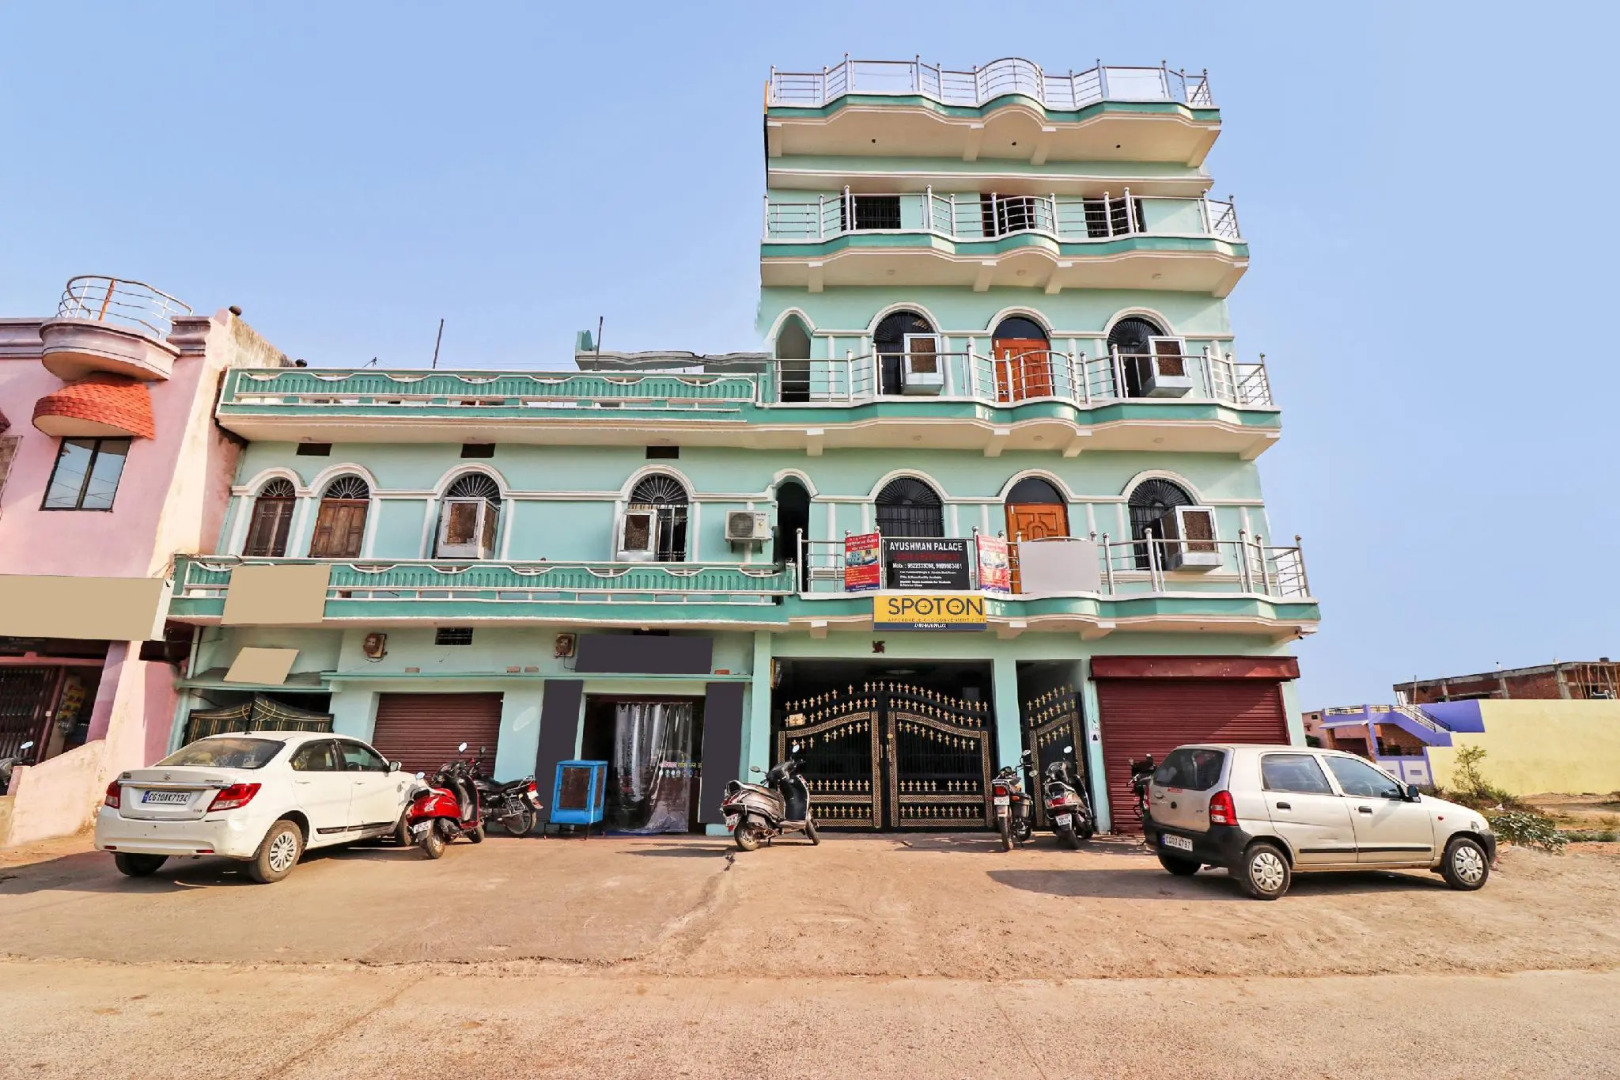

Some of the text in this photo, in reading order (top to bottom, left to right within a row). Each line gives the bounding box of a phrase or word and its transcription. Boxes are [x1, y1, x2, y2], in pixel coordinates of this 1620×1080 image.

[889, 541, 932, 551] AYUSHMAN
[934, 542, 963, 551] PALACE
[888, 597, 984, 615] SPOTON
